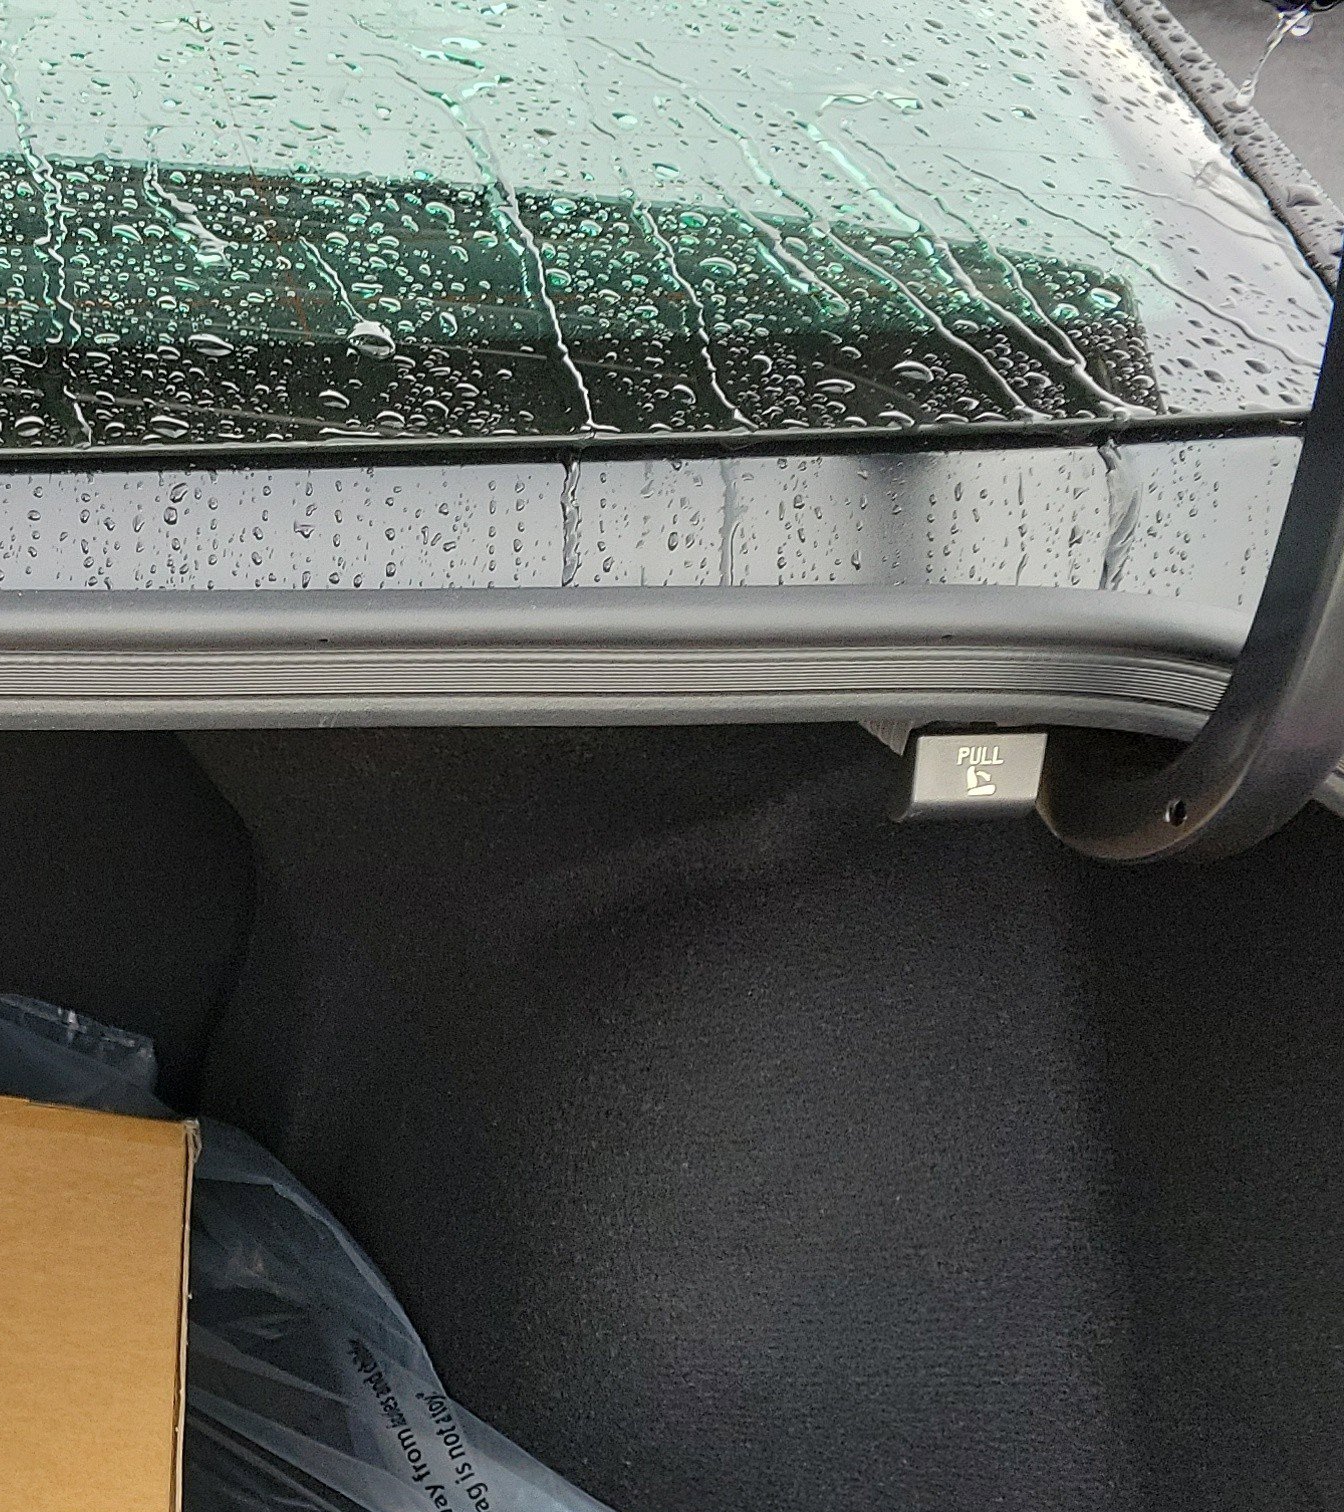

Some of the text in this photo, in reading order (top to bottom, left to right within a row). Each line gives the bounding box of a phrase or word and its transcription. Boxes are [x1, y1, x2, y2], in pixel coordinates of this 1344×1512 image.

[956, 746, 1004, 766] PULL
[398, 1428, 431, 1482] from
[436, 1425, 466, 1460] not
[455, 1462, 474, 1485] is
